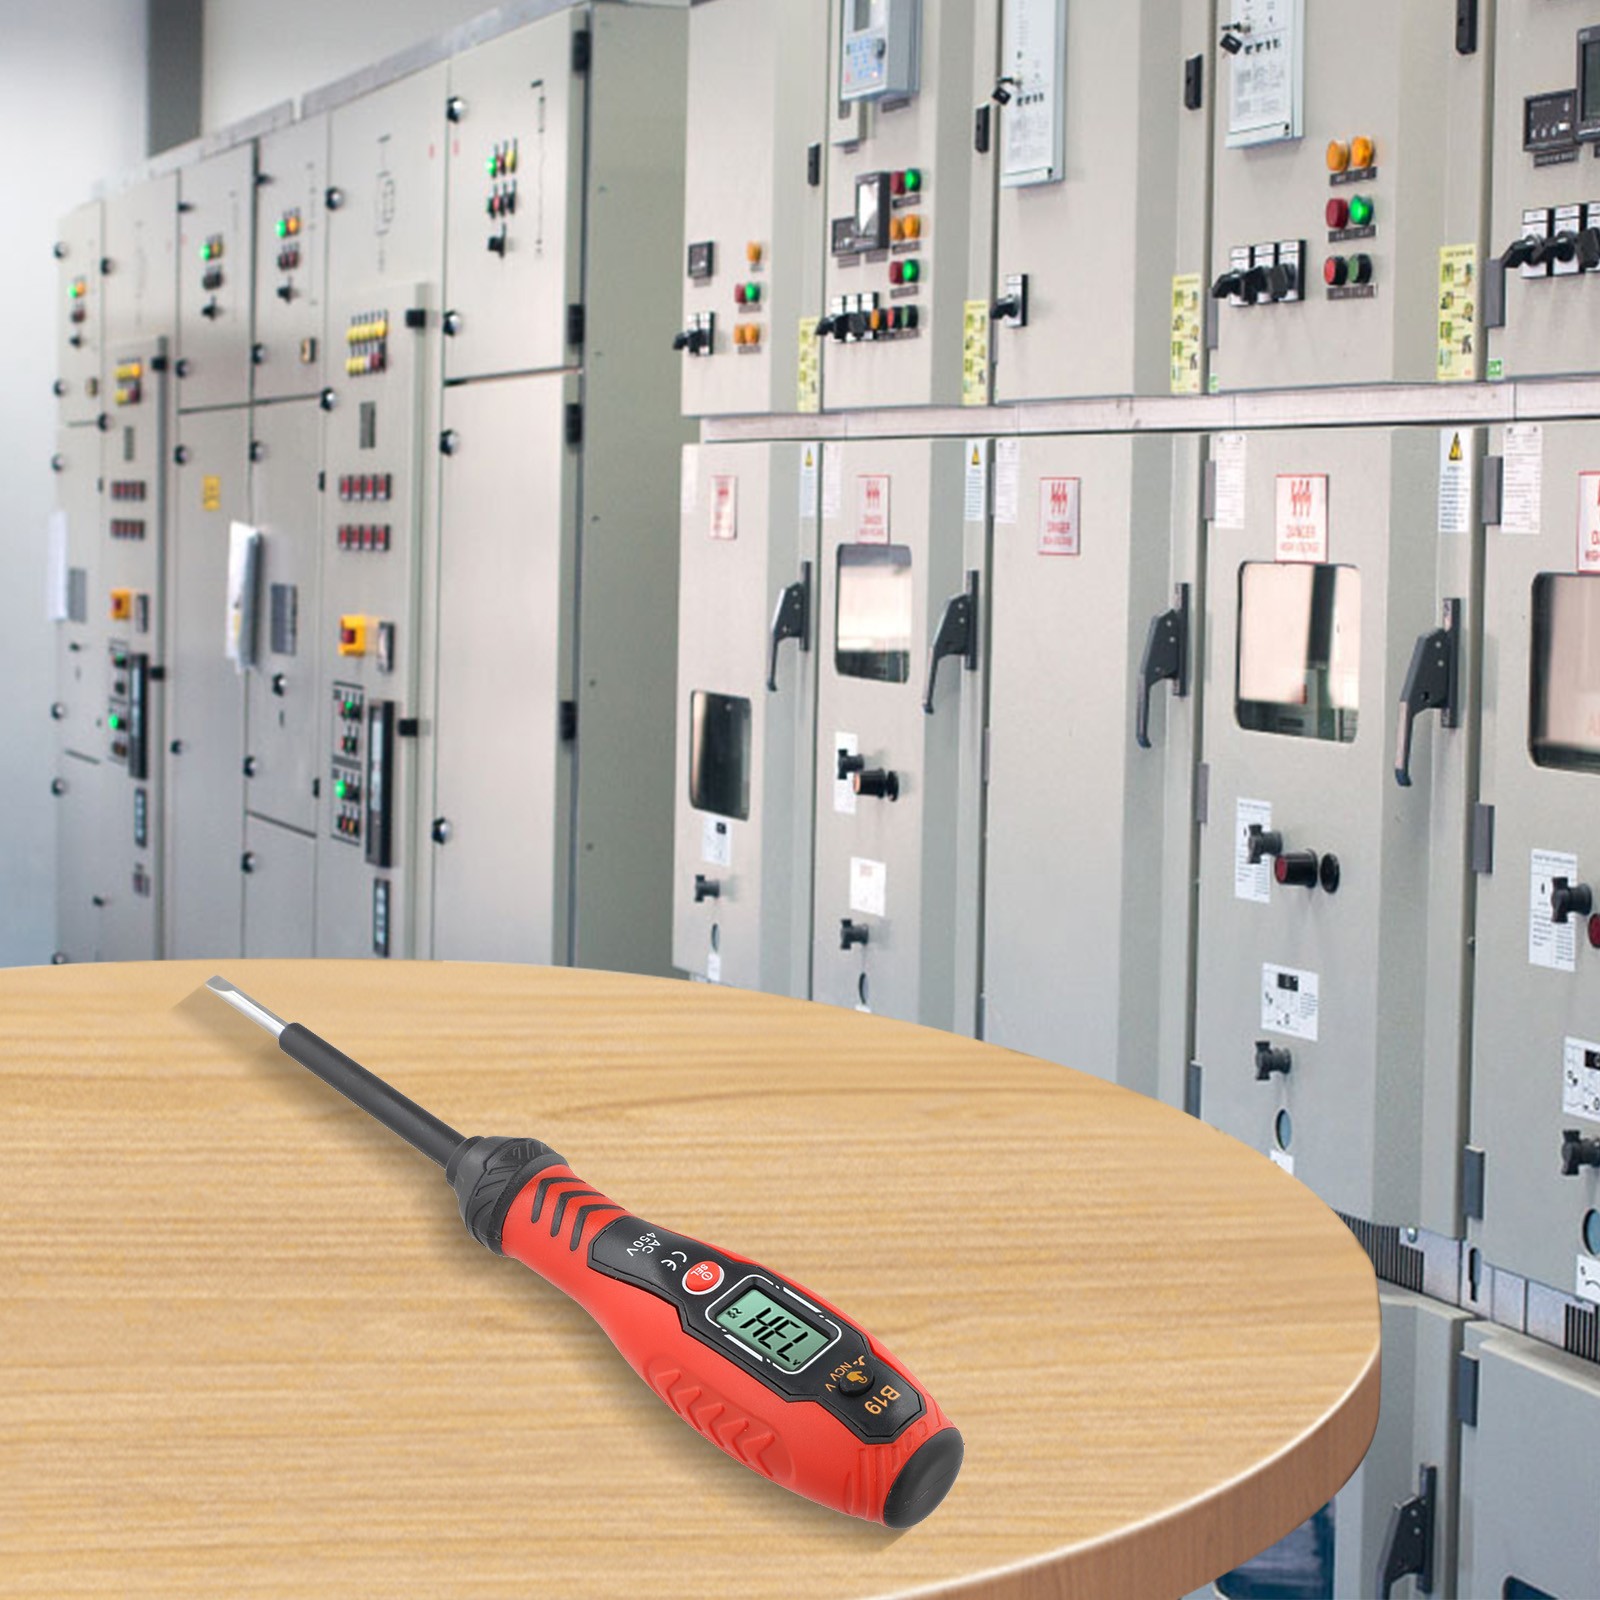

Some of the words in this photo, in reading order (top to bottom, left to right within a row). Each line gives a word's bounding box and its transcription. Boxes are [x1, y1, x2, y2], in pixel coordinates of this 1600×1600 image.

[626, 1232, 656, 1257] 450V
[642, 1239, 661, 1254] AC
[661, 1251, 688, 1271] CE
[690, 1263, 709, 1276] SEL
[739, 1307, 808, 1362] HEL
[829, 1361, 853, 1382] NCV
[824, 1383, 837, 1393] V
[864, 1384, 901, 1415] B19
